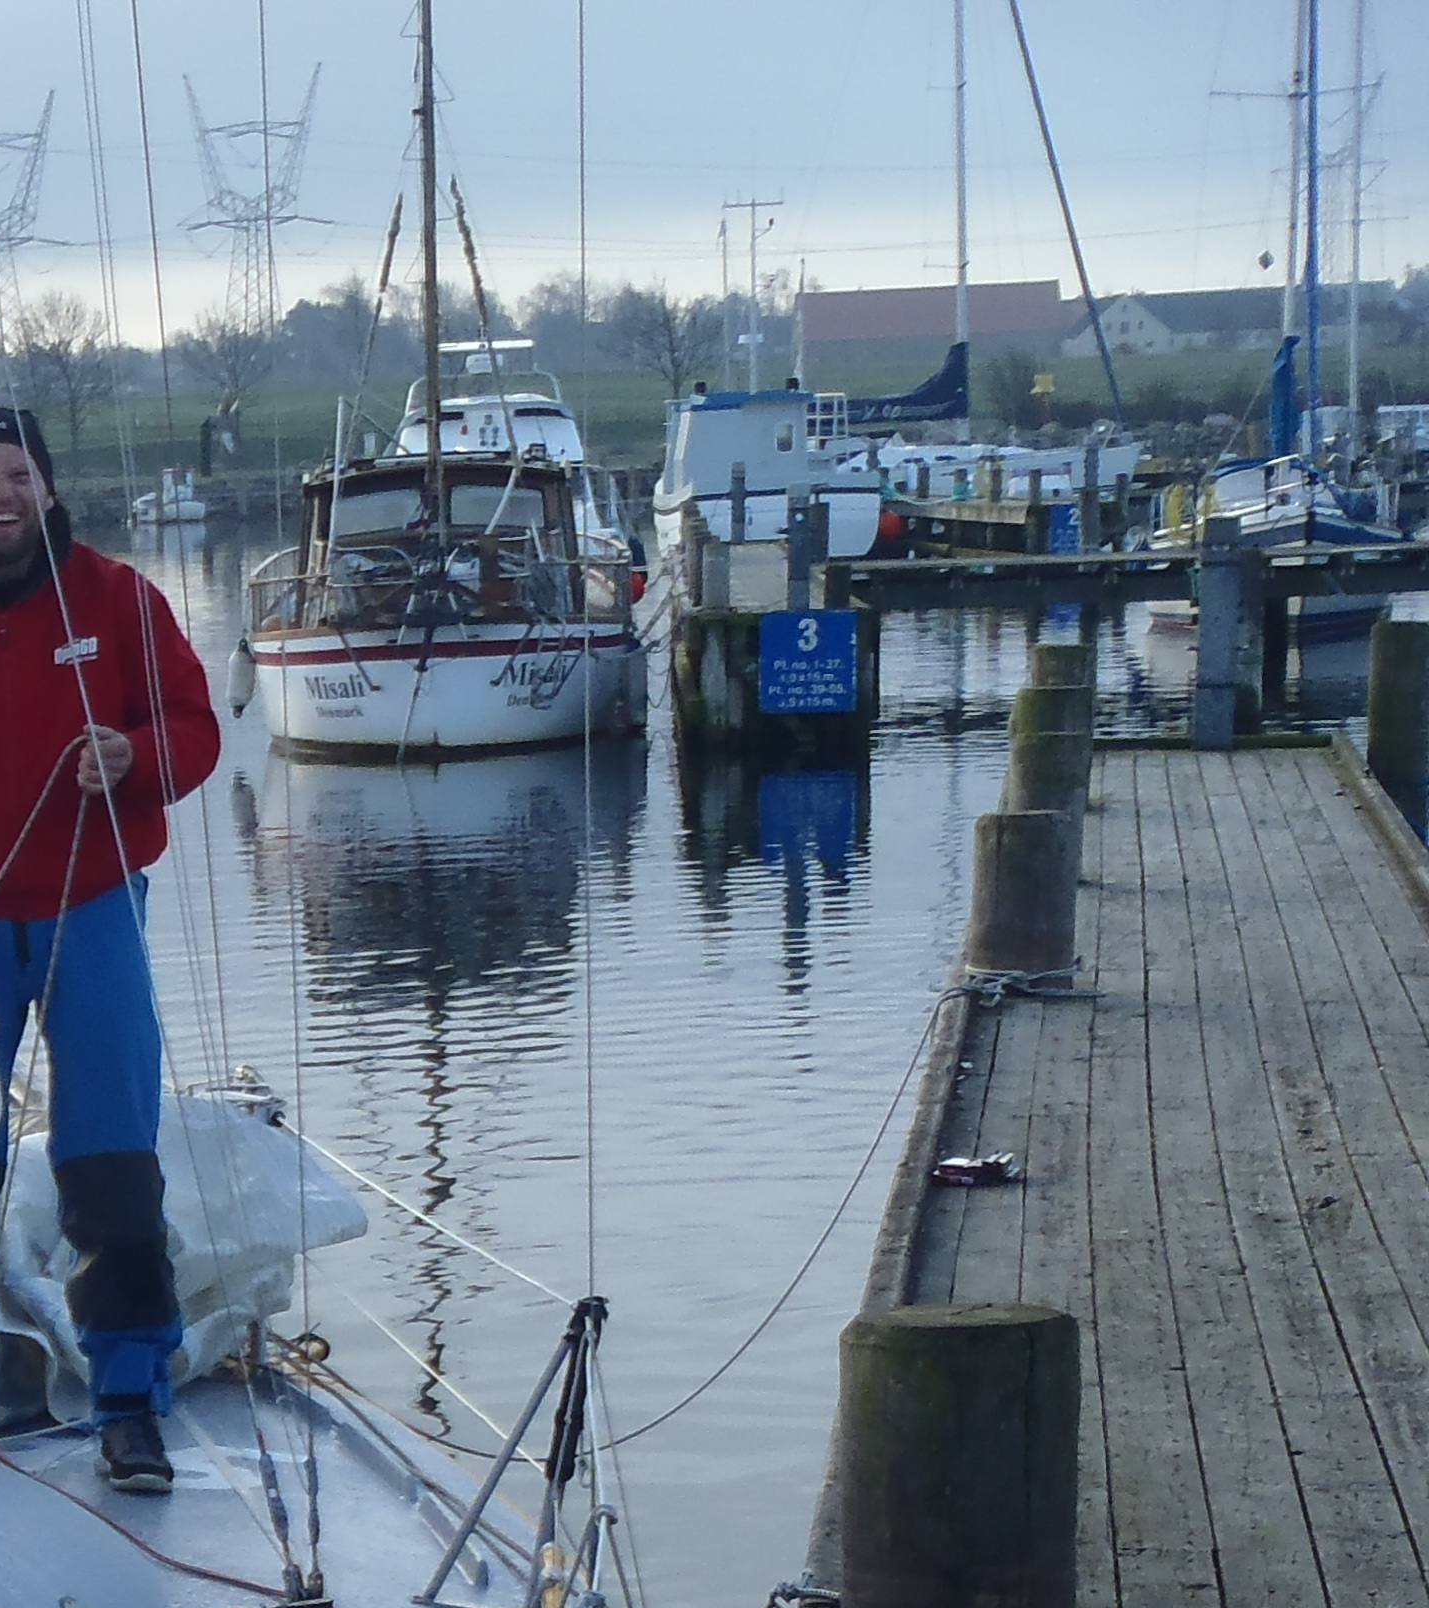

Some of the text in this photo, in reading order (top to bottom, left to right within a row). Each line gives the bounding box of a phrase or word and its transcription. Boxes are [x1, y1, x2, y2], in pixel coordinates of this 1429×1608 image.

[1068, 507, 1082, 526] 2
[797, 617, 819, 652] 3
[304, 673, 367, 701] Misali
